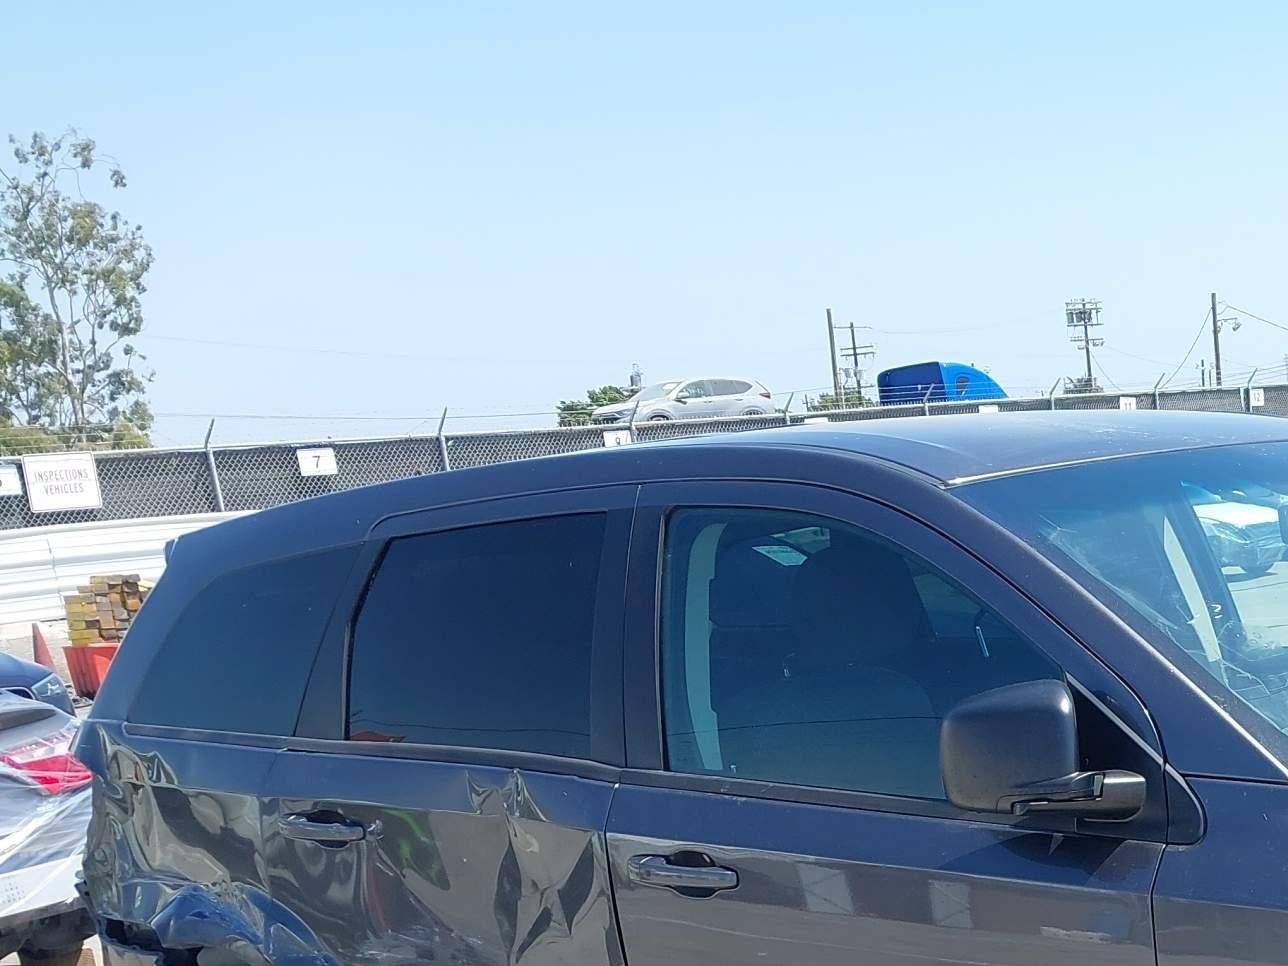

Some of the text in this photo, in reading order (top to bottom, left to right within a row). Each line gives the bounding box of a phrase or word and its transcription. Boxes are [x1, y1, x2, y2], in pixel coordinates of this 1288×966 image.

[1253, 391, 1261, 402] 12
[312, 455, 321, 469] 7
[33, 468, 89, 482] INSPECTIONS
[43, 482, 85, 496] VEHICLES
